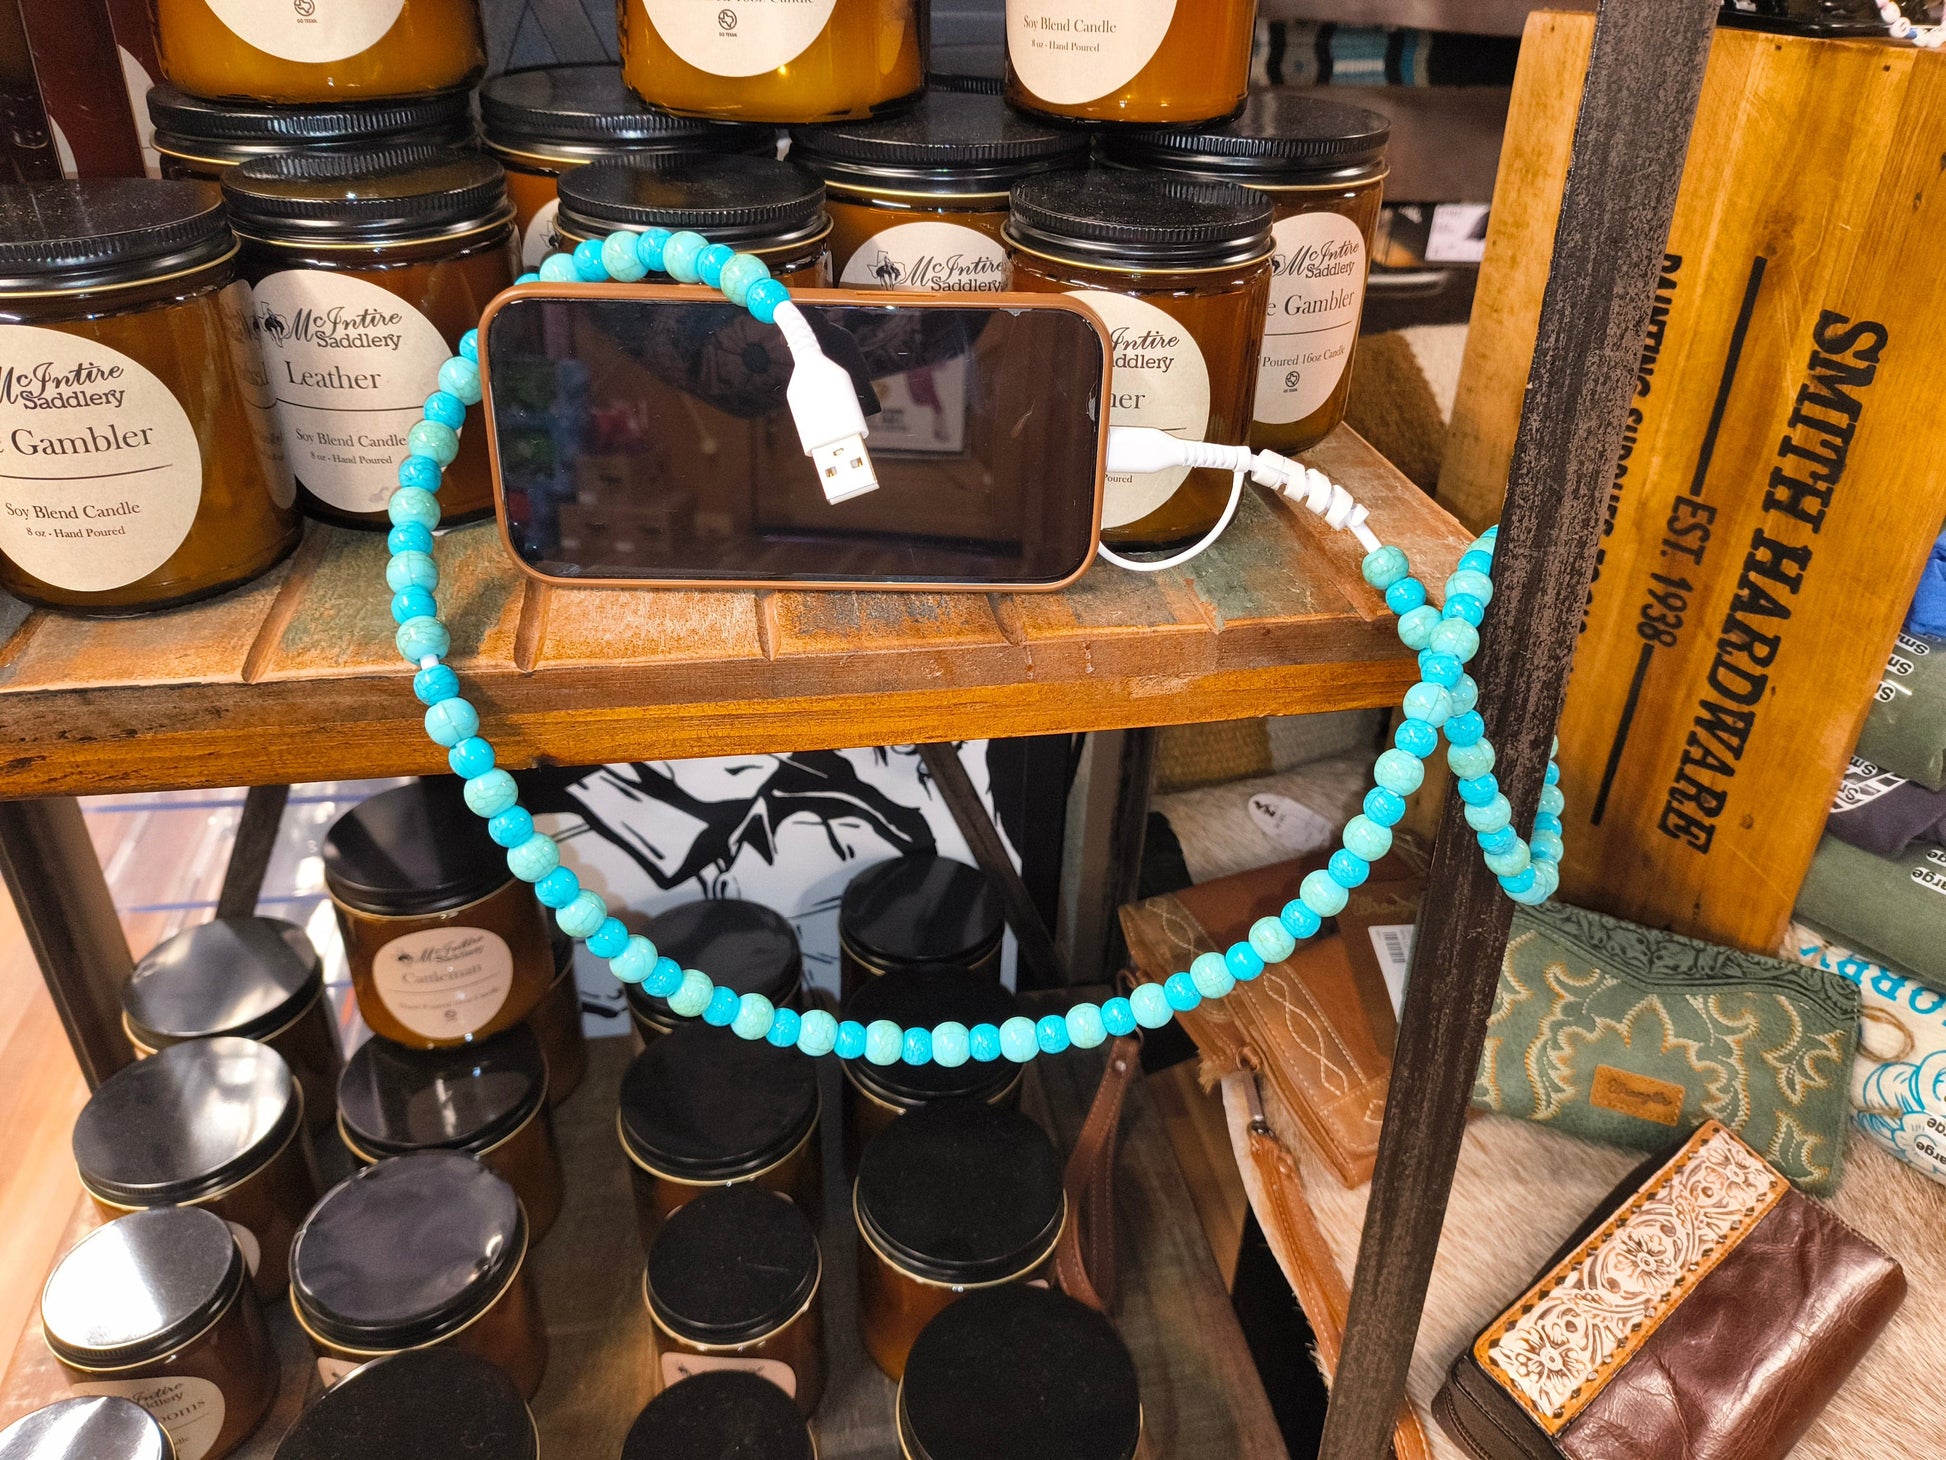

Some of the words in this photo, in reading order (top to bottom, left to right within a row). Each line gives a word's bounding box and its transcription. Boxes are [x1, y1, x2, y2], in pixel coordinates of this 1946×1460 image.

[1023, 15, 1038, 32] Soy
[1040, 16, 1070, 32] Blend
[1073, 18, 1117, 34] Candle
[1049, 41, 1068, 51] Hand
[1071, 42, 1100, 52] Poured
[1286, 240, 1360, 276] McIntire
[902, 254, 1002, 287] McIntire
[1305, 261, 1356, 279] Saddlery
[1284, 288, 1356, 316] Gambler
[287, 306, 402, 342] McIntire
[315, 330, 402, 350] Saddlery
[1110, 327, 1180, 351] Intire
[1112, 353, 1174, 373] ddlery
[1262, 355, 1299, 368] Poured
[1302, 352, 1322, 365] 16oz
[284, 360, 382, 390] Leather
[20, 389, 126, 410] Saddlery
[1762, 309, 1888, 535] SMITH
[11, 424, 153, 456] Gambler
[295, 428, 315, 443] Soy
[317, 432, 354, 448] Blend
[358, 434, 407, 448] Candle
[332, 454, 357, 464] Hand
[359, 455, 393, 465] Poured
[5, 502, 29, 520] Soy
[33, 504, 79, 520] Blend
[82, 501, 142, 519] Candle
[26, 527, 34, 537] 8
[34, 530, 47, 538] oz
[54, 528, 84, 539] Hand
[86, 525, 126, 538] Poured
[1660, 495, 1718, 567] EST.
[1636, 572, 1694, 648] 1938
[1656, 527, 1813, 855] HARDWARE
